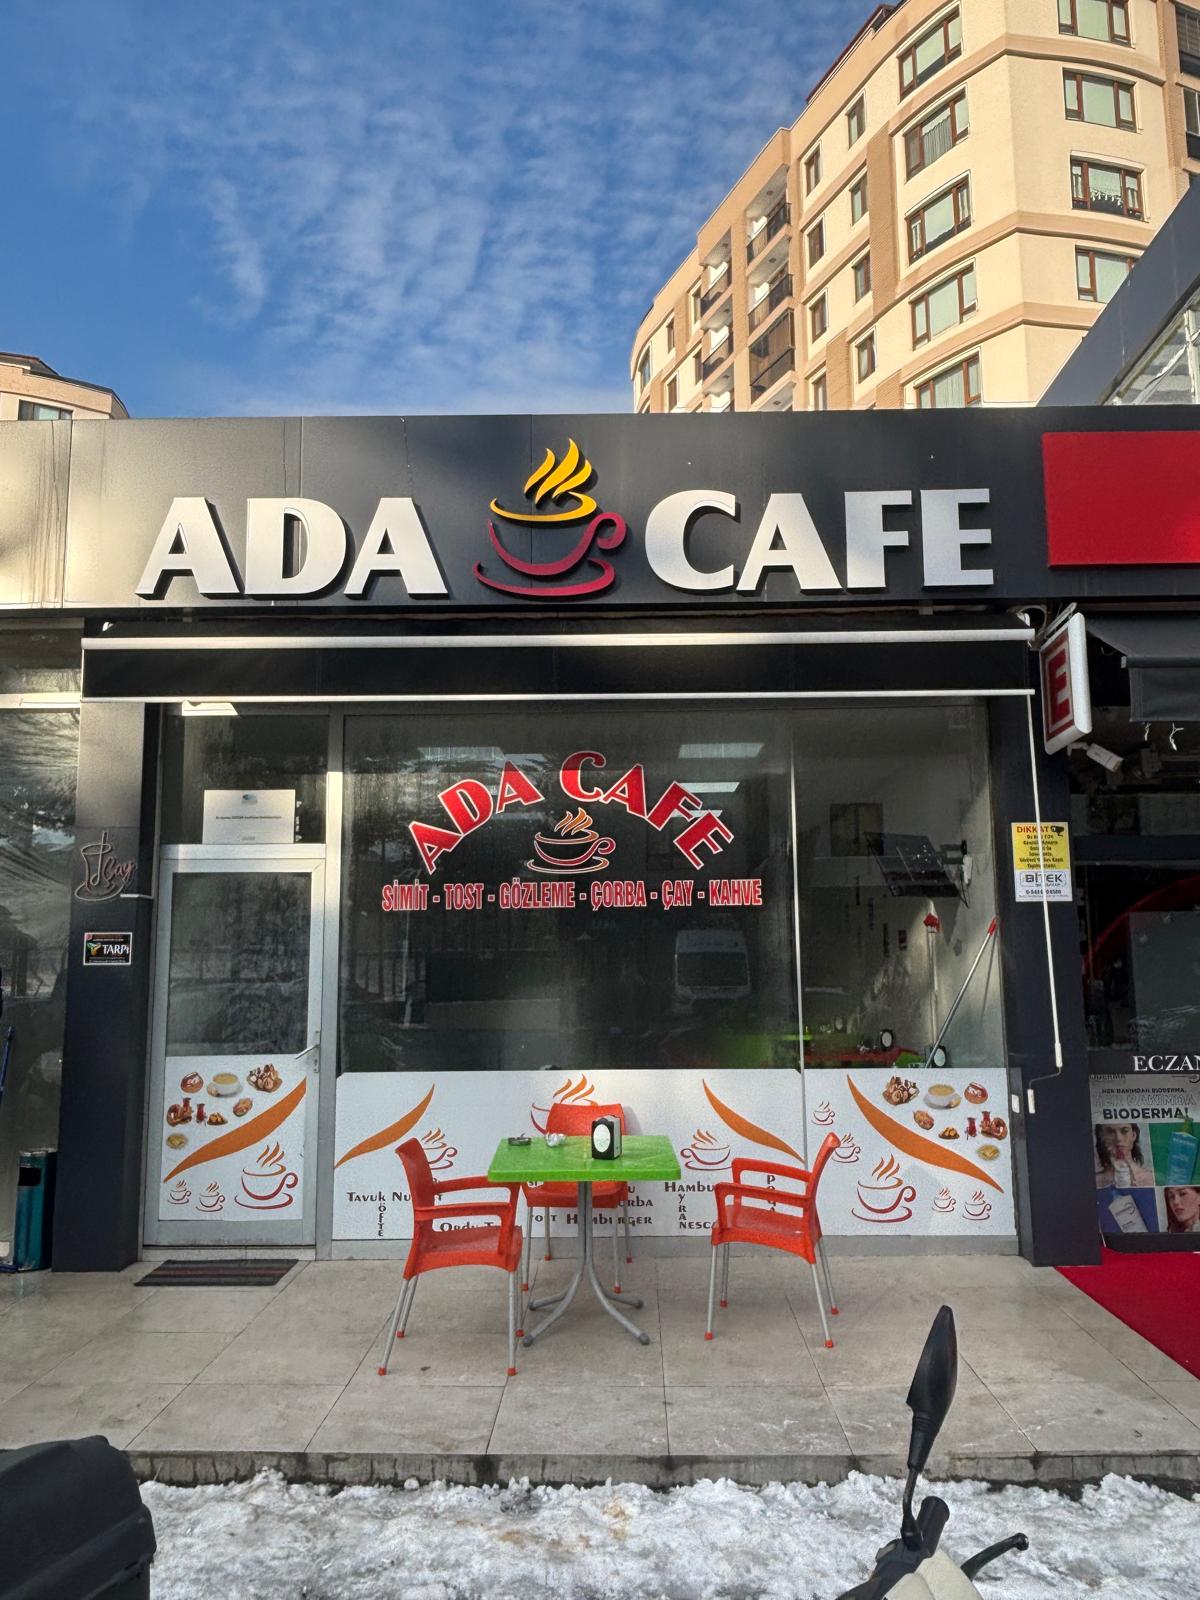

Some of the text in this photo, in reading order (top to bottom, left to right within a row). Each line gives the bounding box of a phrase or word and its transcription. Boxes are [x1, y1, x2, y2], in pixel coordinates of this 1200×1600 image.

[135, 488, 994, 599] ADA CAFE
[409, 750, 734, 874] ADA CAFE
[382, 879, 429, 911] SİMİT
[444, 883, 484, 910] TOST
[499, 877, 576, 909] GÖZLEME
[591, 880, 646, 911] ÇORBA
[662, 880, 694, 911] ÇAY
[709, 878, 762, 907] KAHVE
